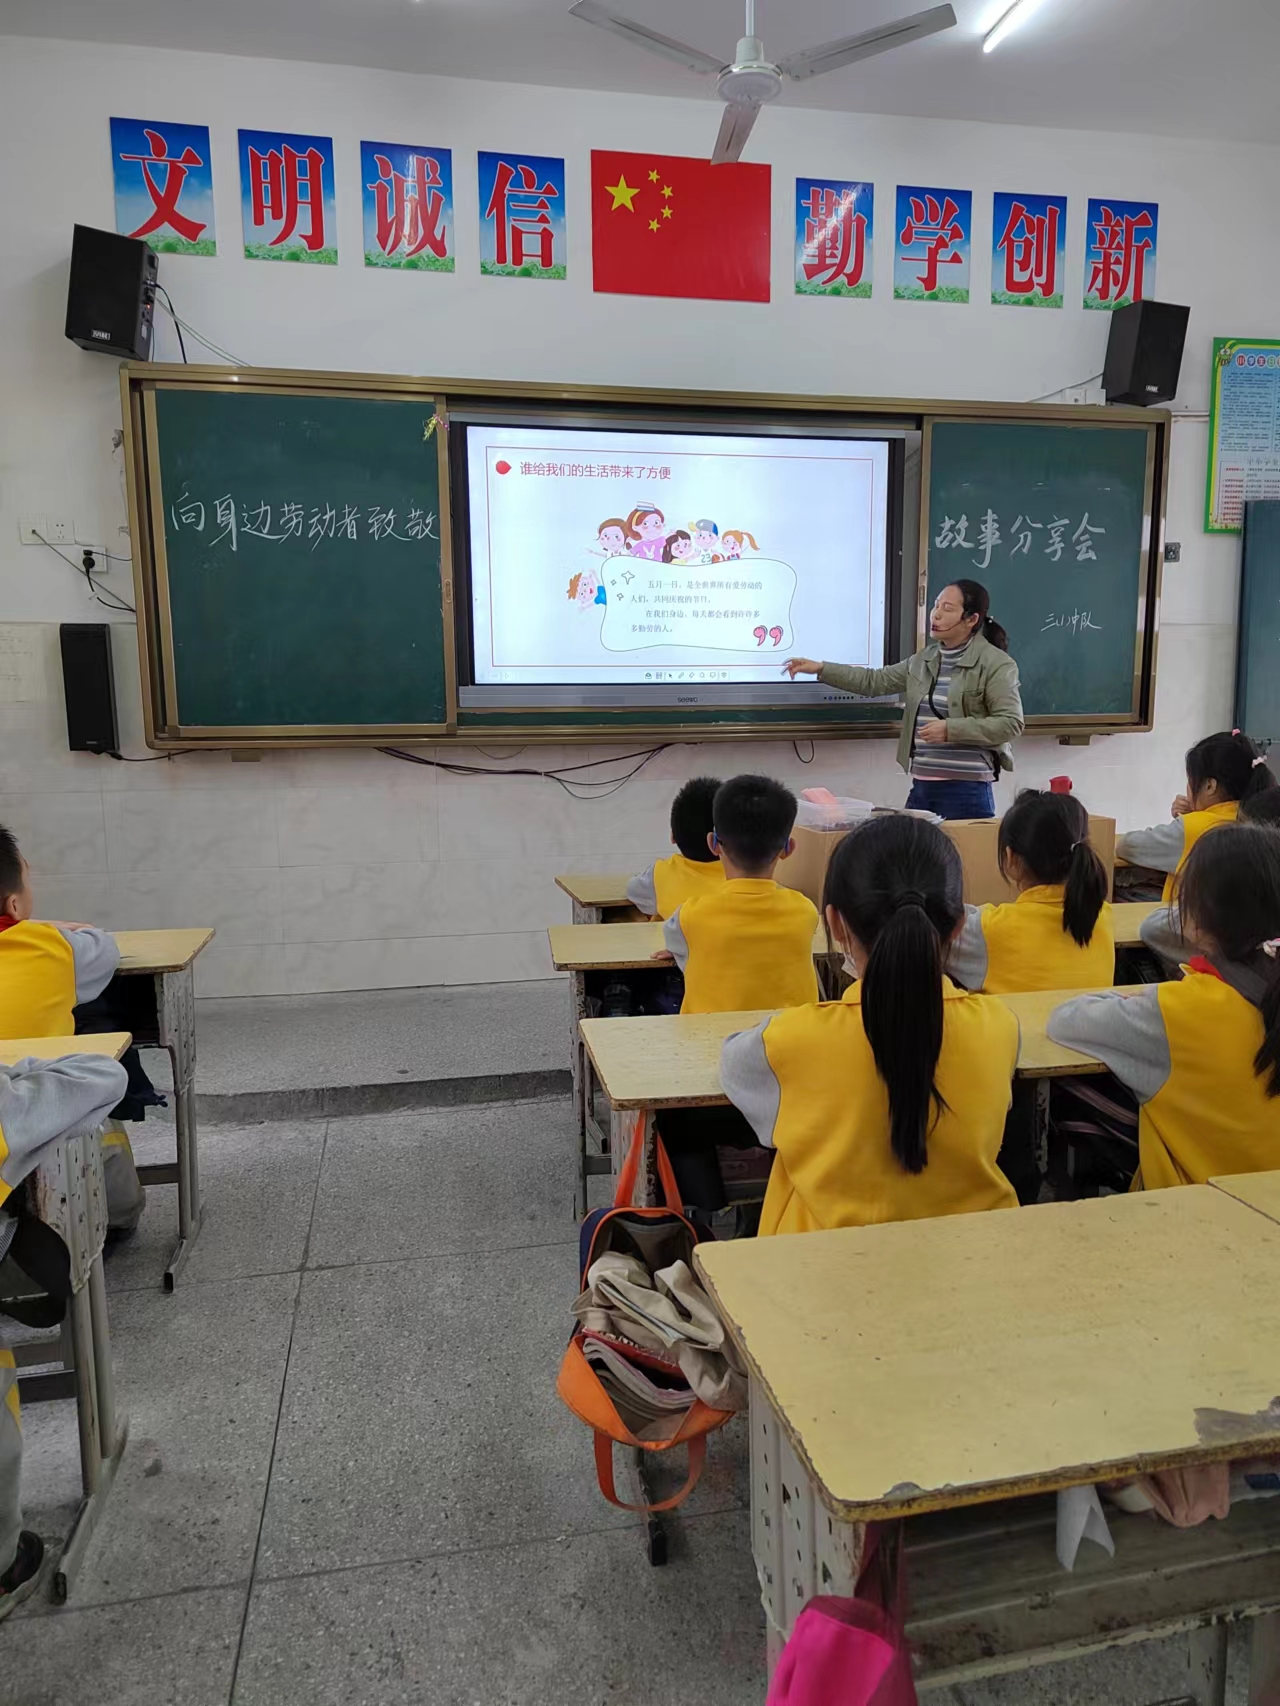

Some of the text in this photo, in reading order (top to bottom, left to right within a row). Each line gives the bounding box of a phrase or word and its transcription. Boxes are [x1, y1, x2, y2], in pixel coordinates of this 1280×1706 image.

[520, 461, 671, 480] 谁给我们的生活带来了方便
[171, 492, 440, 551] 向身边劳动者致敬
[935, 508, 1106, 568] 故事分享会
